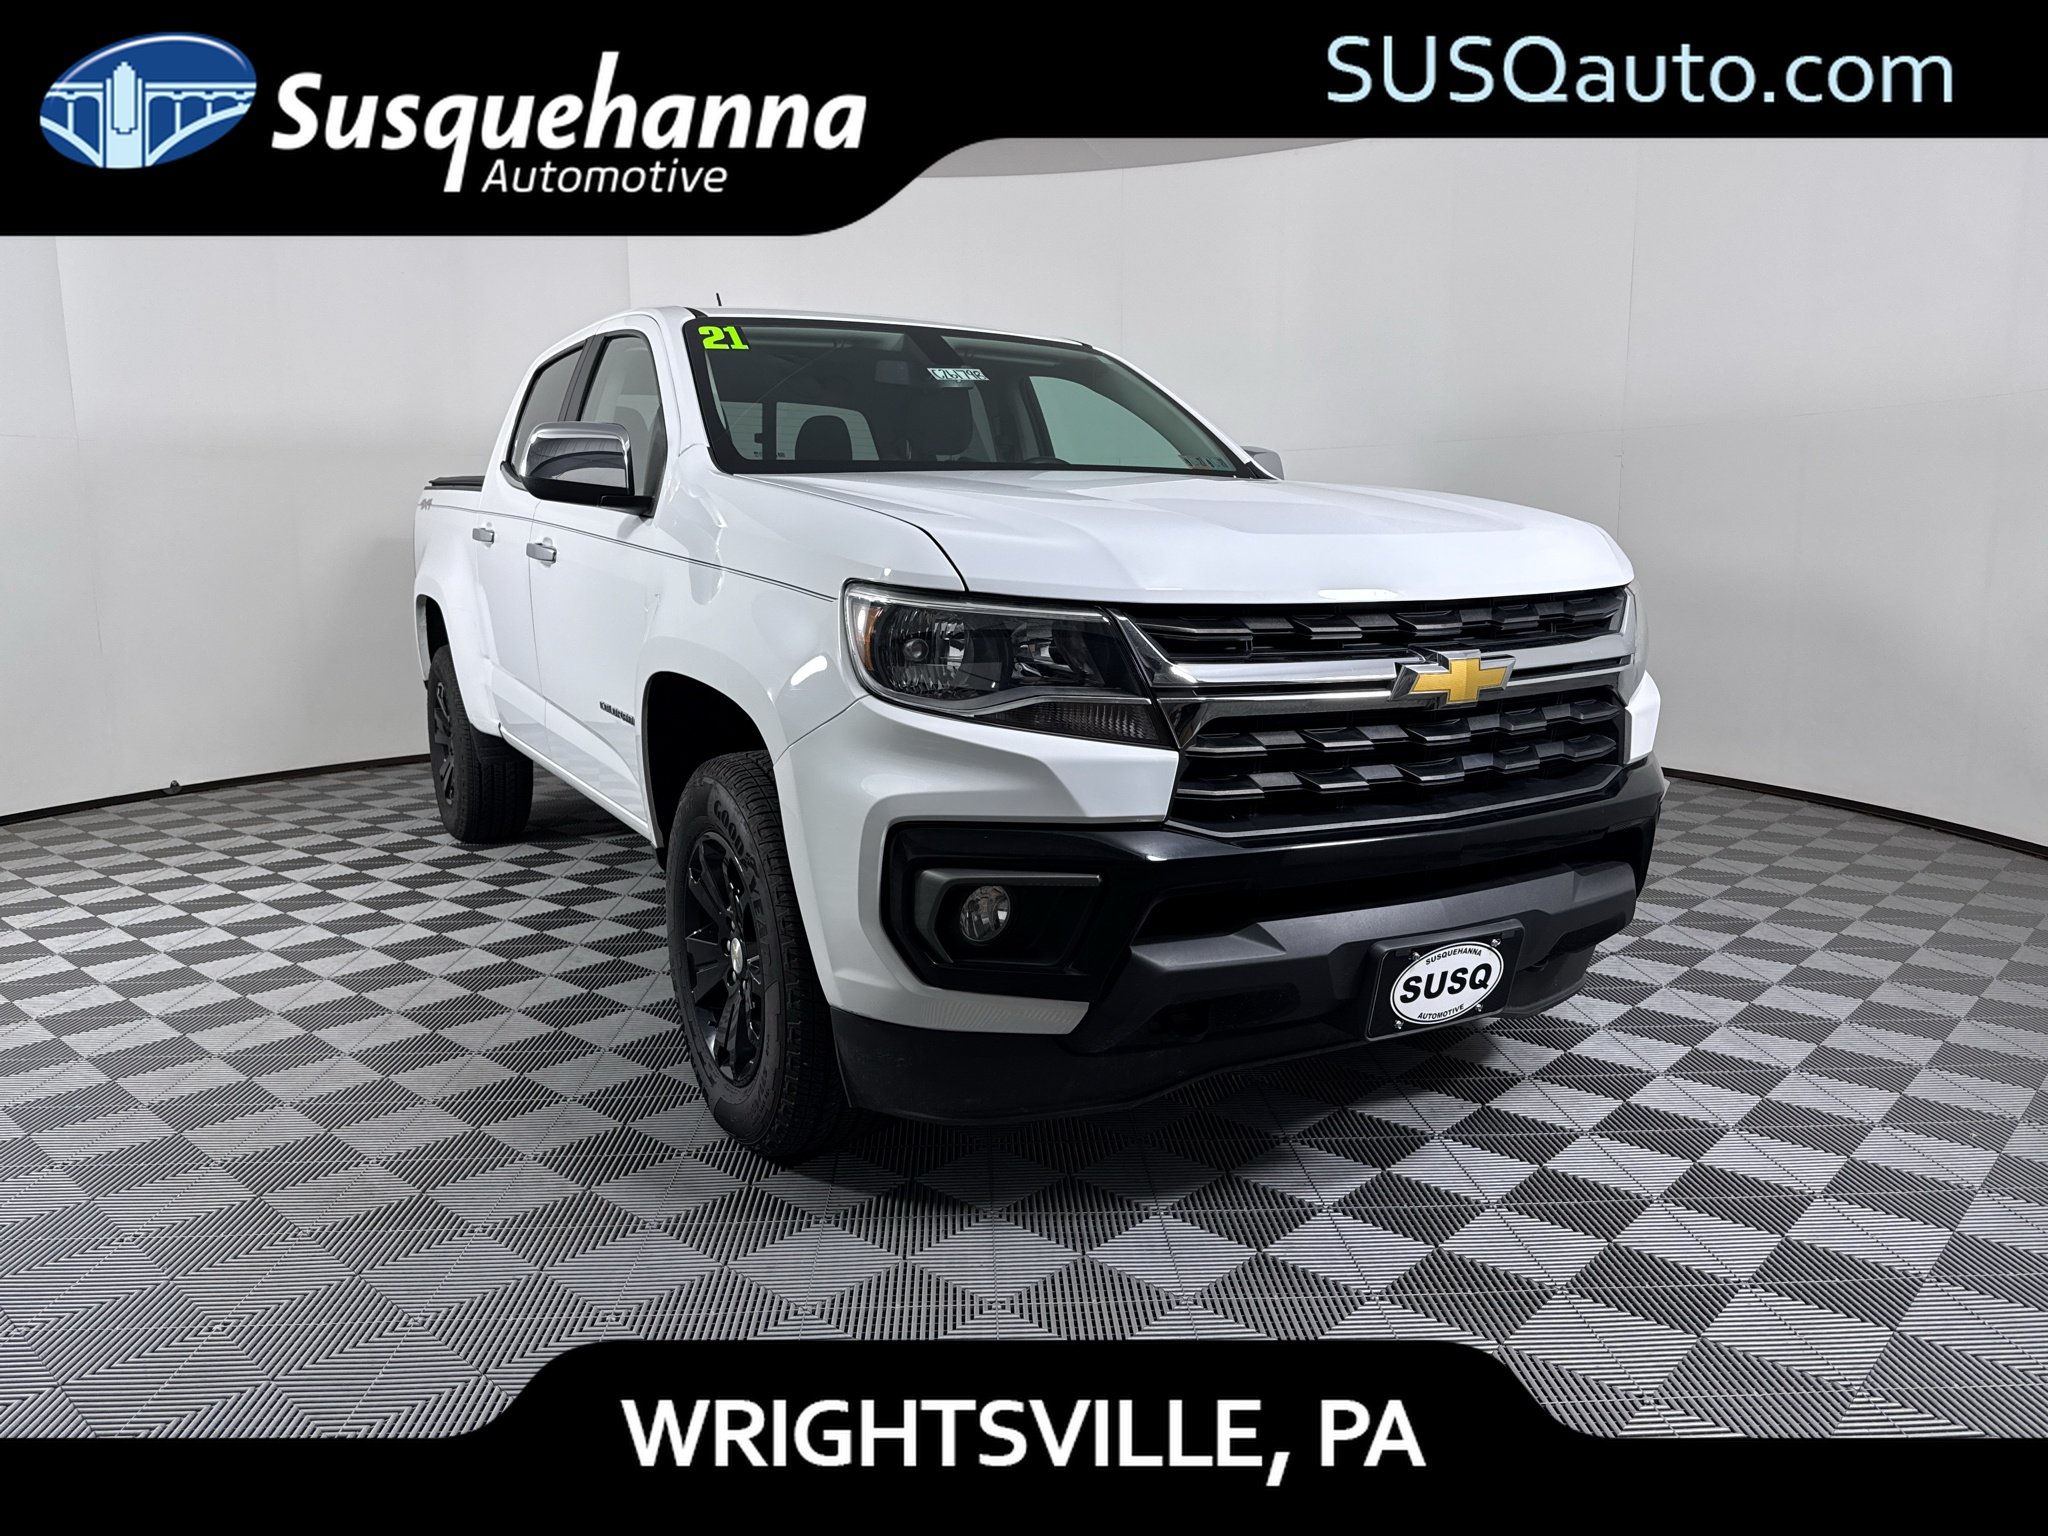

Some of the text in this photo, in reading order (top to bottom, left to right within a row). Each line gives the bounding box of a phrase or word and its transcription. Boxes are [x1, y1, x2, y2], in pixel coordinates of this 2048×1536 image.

[698, 326, 748, 350] 21
[1425, 948, 1482, 965] SUSQUEHANNA
[1399, 963, 1493, 1004] SUSQ
[1417, 1003, 1465, 1019] AUTOMOTIVE
